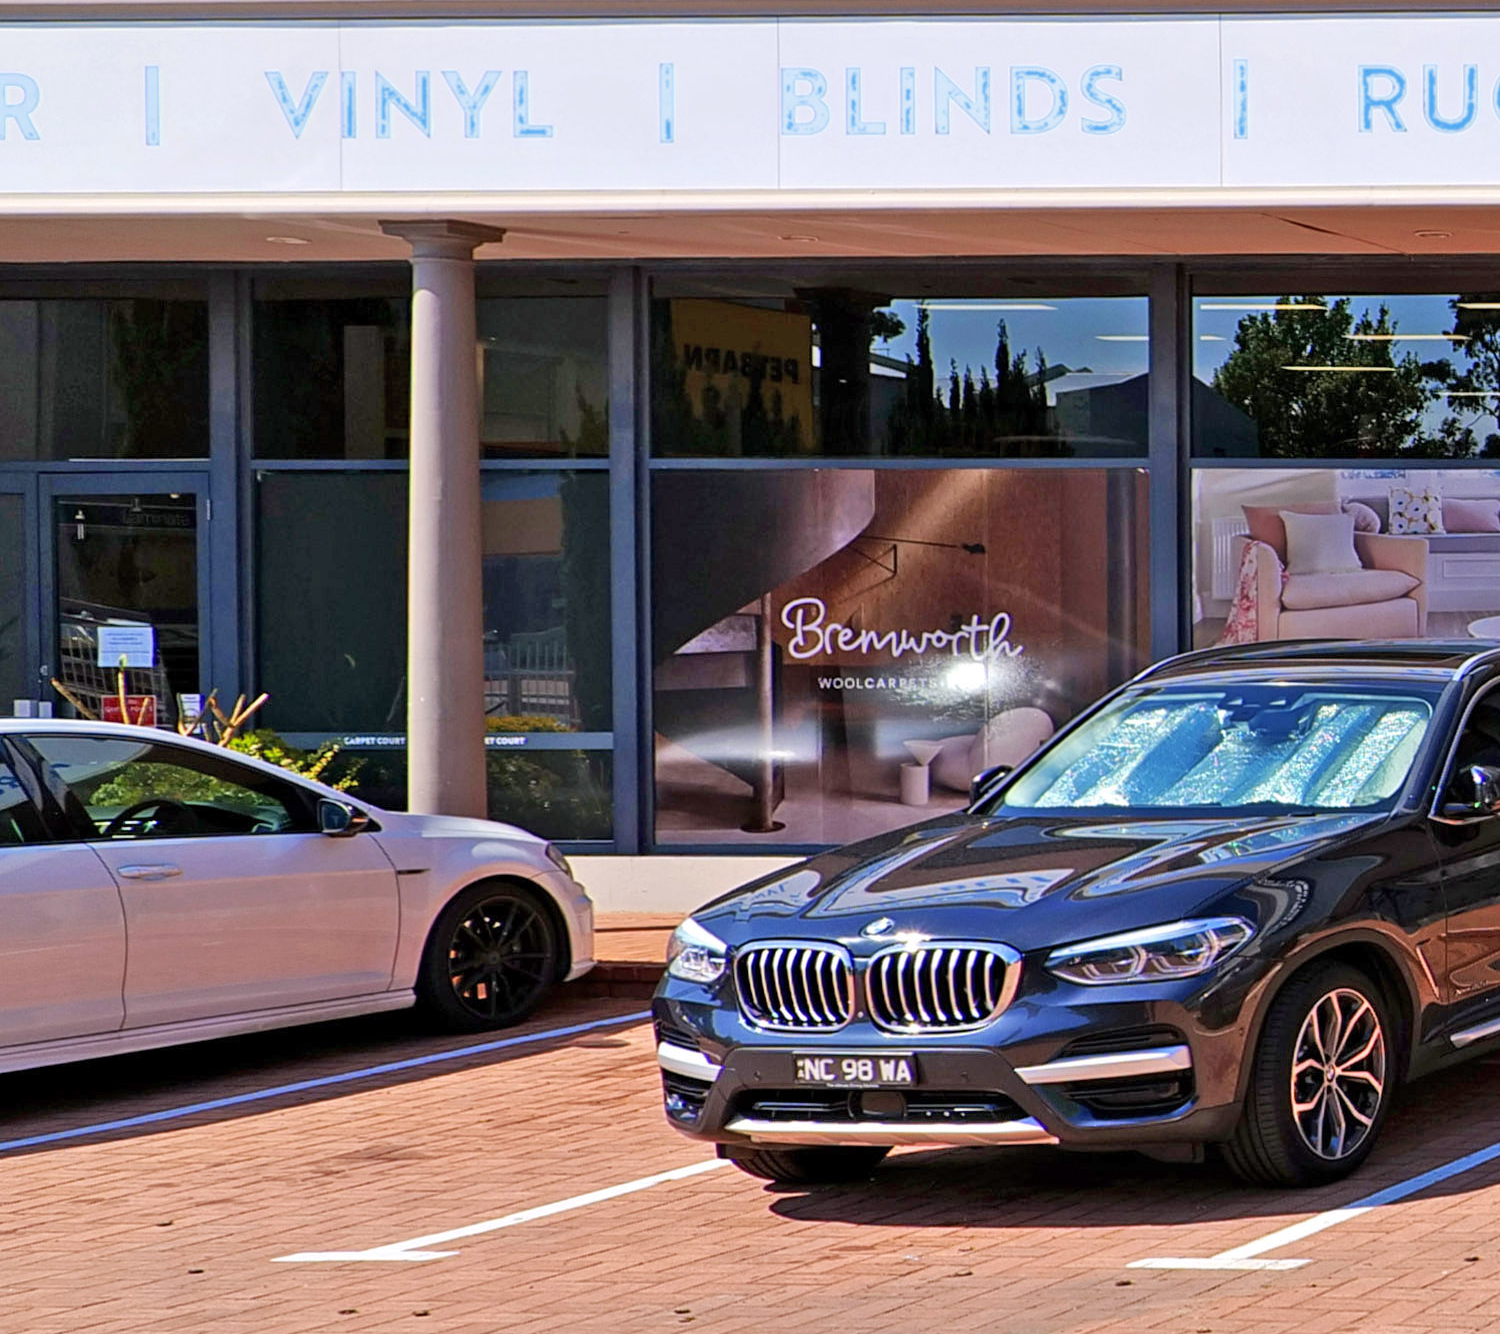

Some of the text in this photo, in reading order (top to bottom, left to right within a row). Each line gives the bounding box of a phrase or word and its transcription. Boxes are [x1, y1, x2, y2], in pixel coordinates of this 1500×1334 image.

[263, 70, 554, 140] VINYL
[779, 64, 1128, 136] BLINDS
[781, 597, 1024, 661] Bremworth
[376, 736, 407, 746] COURT
[495, 736, 526, 746] COURT
[803, 1057, 837, 1081] NC
[840, 1058, 875, 1082] 98
[878, 1058, 913, 1083] WA
